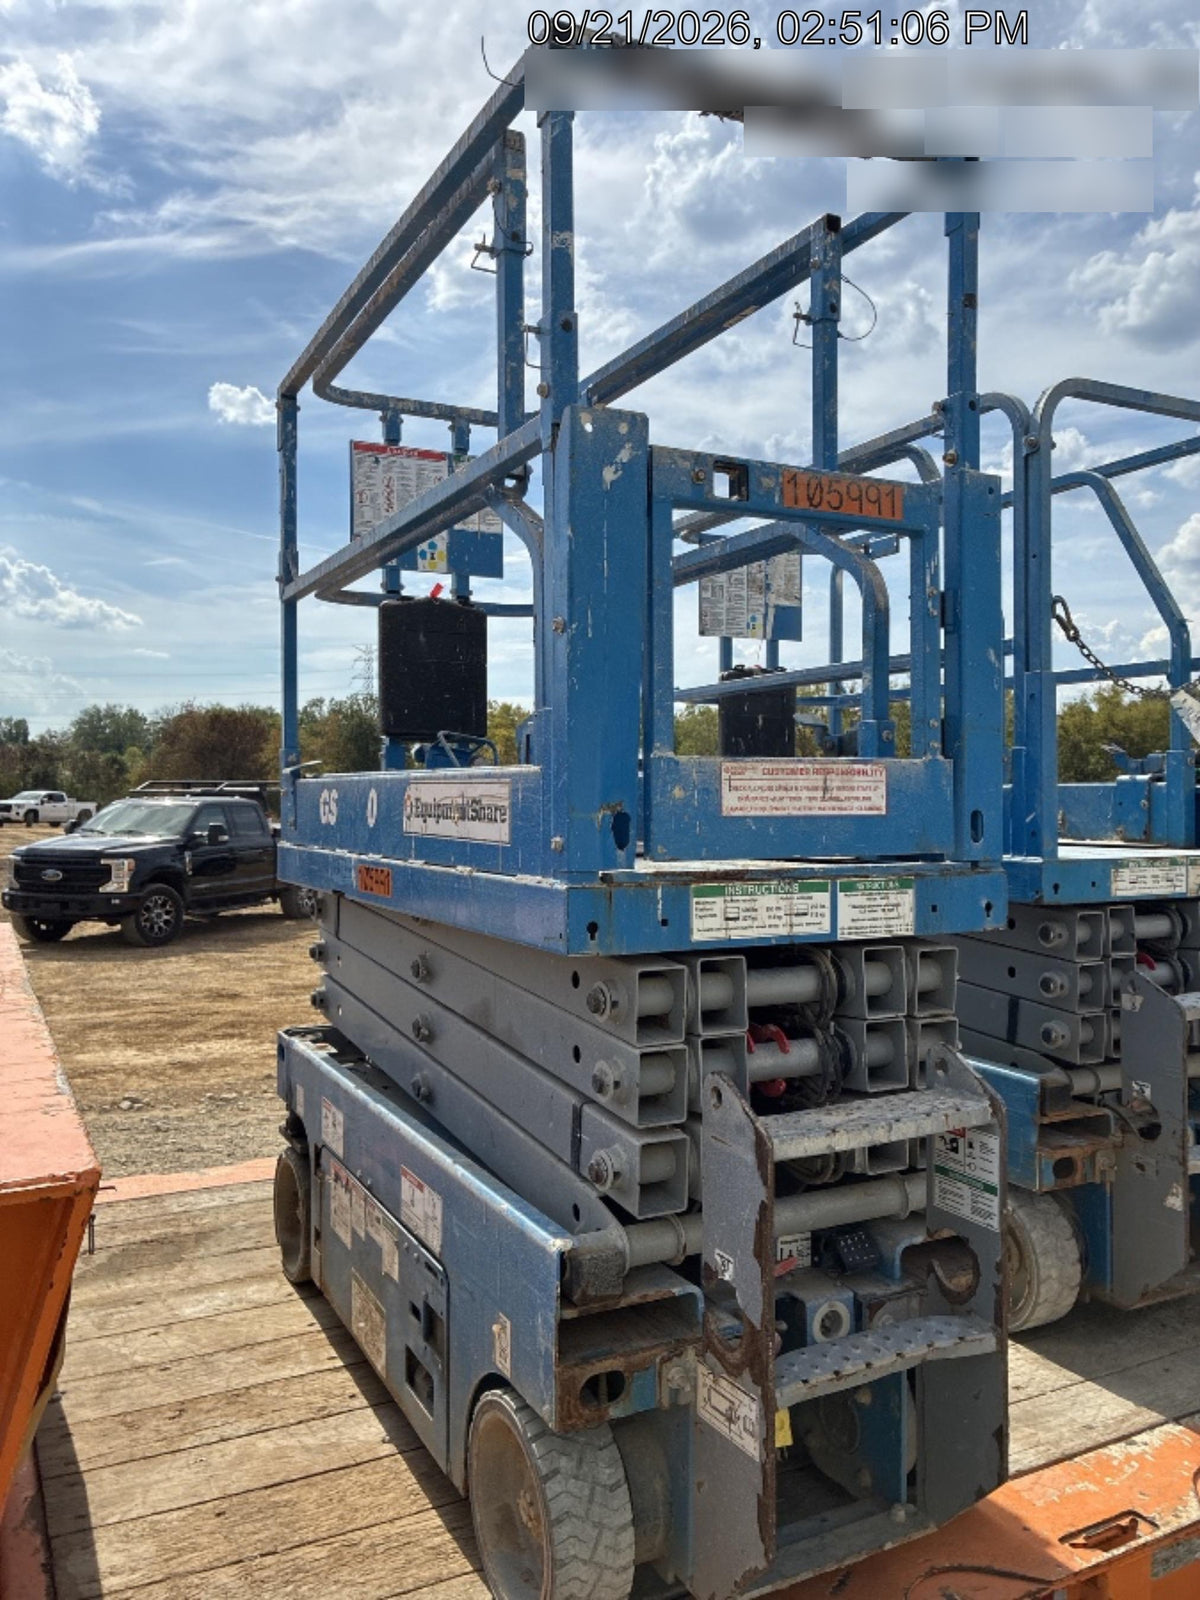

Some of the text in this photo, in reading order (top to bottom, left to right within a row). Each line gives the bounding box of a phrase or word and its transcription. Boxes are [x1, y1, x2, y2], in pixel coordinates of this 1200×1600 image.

[787, 472, 896, 518] 105991
[320, 789, 338, 825] GS
[414, 796, 508, 824] EquipmtShare
